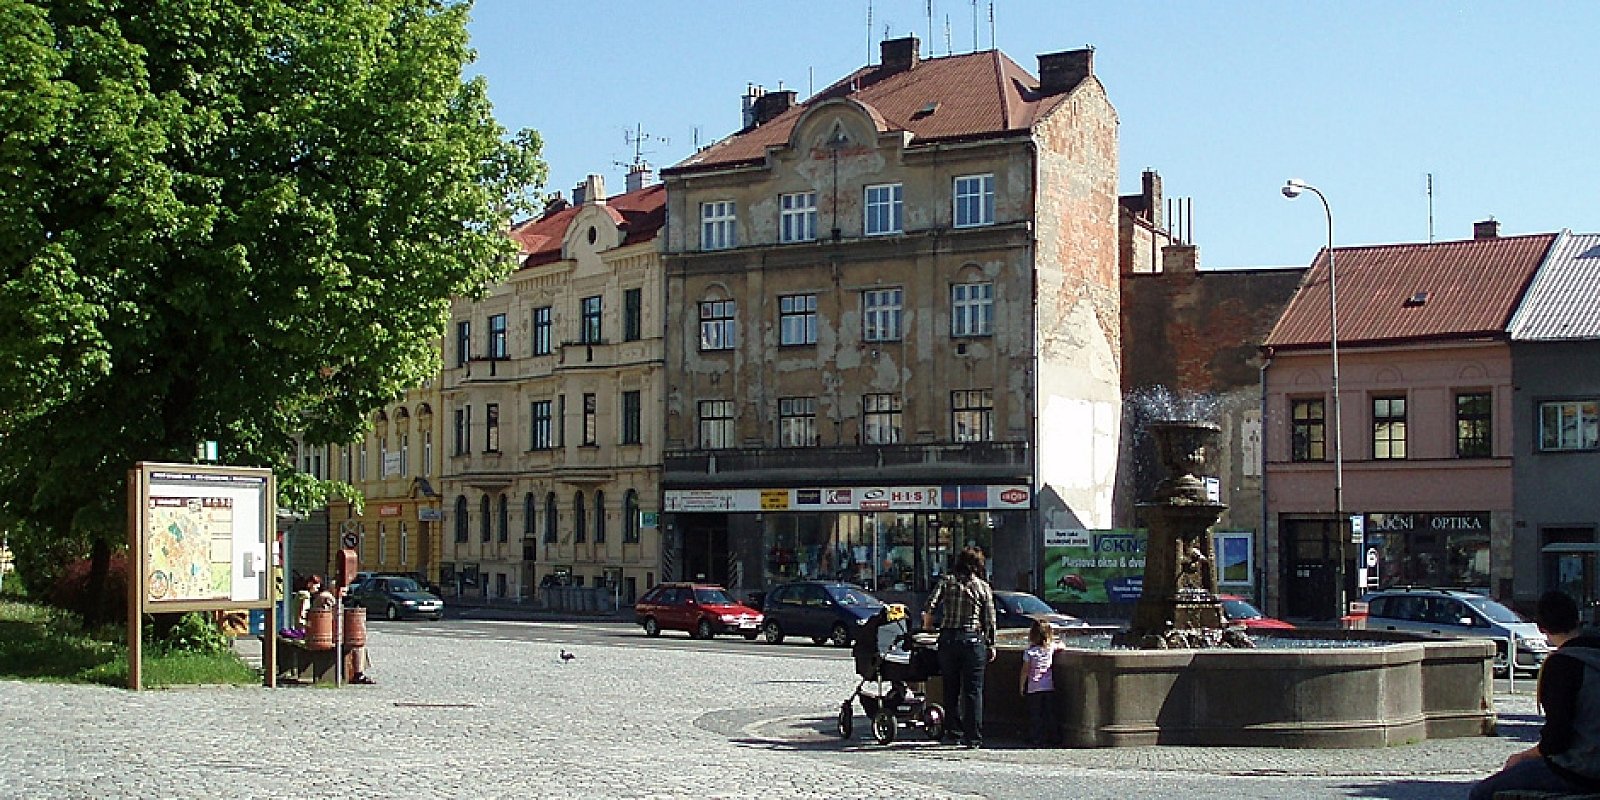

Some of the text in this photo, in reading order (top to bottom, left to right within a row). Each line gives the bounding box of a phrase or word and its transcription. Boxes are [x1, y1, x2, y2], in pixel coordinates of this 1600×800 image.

[1431, 516, 1482, 529] OPTIKA
[1098, 556, 1118, 568] okna
[1119, 556, 1127, 568] &
